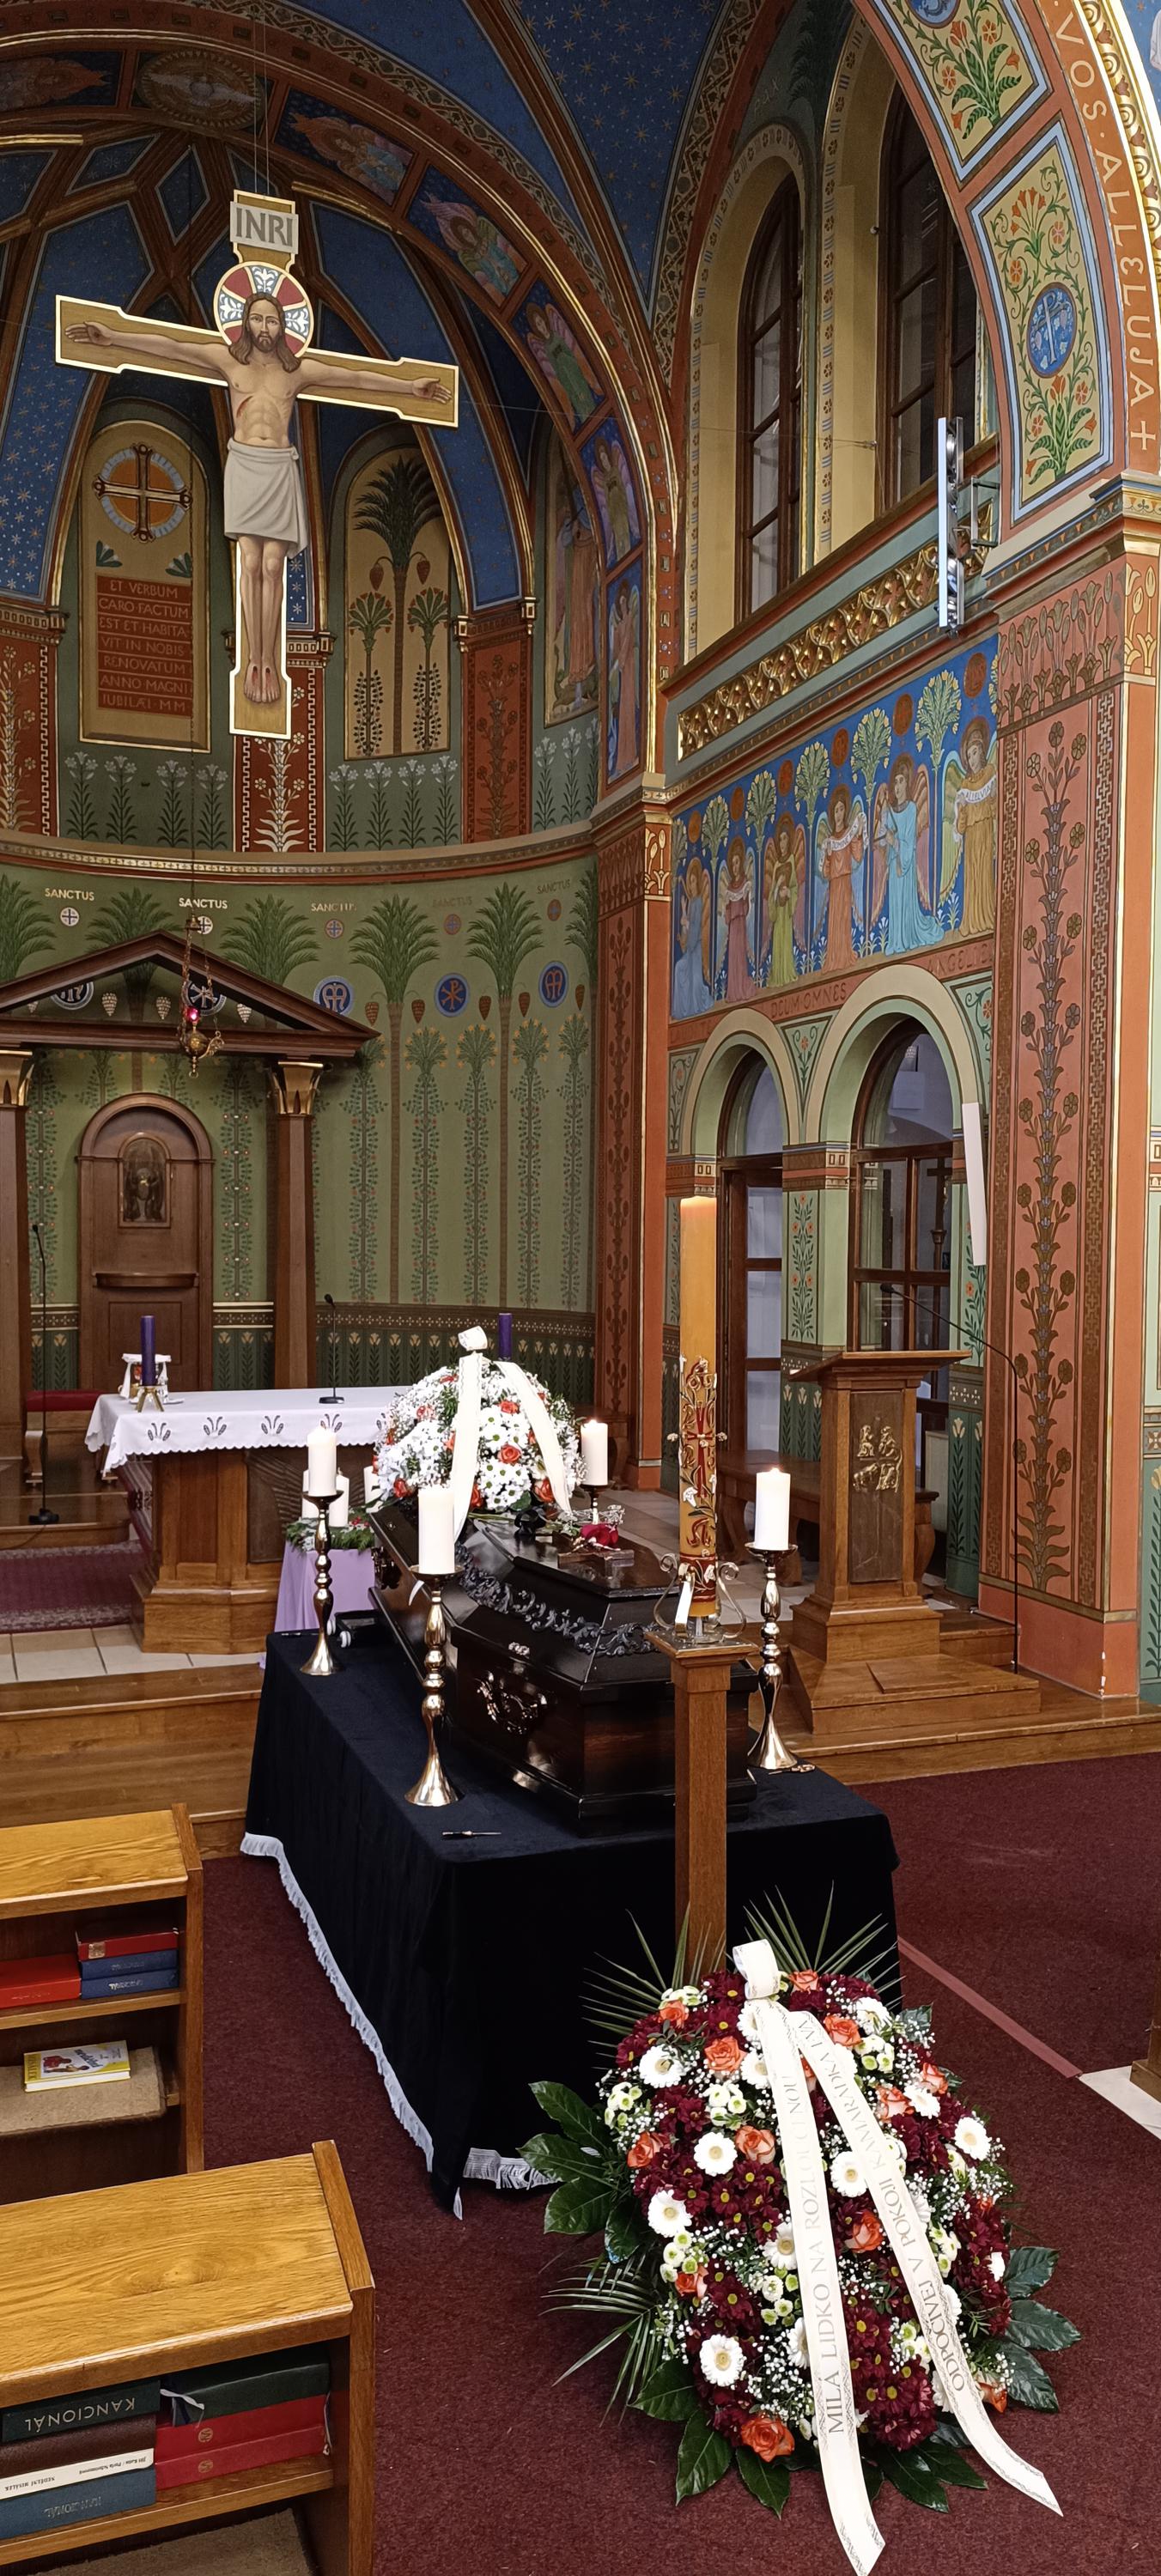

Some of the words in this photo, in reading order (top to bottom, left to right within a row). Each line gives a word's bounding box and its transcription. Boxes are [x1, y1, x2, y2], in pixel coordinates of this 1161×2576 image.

[1055, 11, 1108, 120] VOS
[1095, 148, 1155, 406] ALLELUJA
[235, 207, 294, 247] INRI
[110, 580, 123, 592] ET
[129, 581, 179, 599] VERBUM
[98, 597, 135, 613] CARO
[138, 602, 189, 619] FACTUM
[99, 617, 120, 629] EST
[124, 620, 139, 632] ET
[100, 636, 121, 648] VIT
[125, 639, 141, 652] IN
[146, 641, 185, 657] NOBIS
[103, 655, 186, 675] RENOVATUM
[100, 674, 142, 690] ANNO
[146, 682, 188, 695] MAGNI
[44, 887, 95, 902] SANCTUS
[537, 878, 571, 895] SANCTUS
[179, 897, 228, 909] SANCTUS
[878, 2178, 917, 2247] POKOJI
[808, 2239, 828, 2275] NA
[908, 2257, 925, 2273] V
[812, 2283, 838, 2359] LIDKO
[818, 2370, 845, 2434] MILÁ
[25, 2397, 136, 2433] KANCIONÁL
